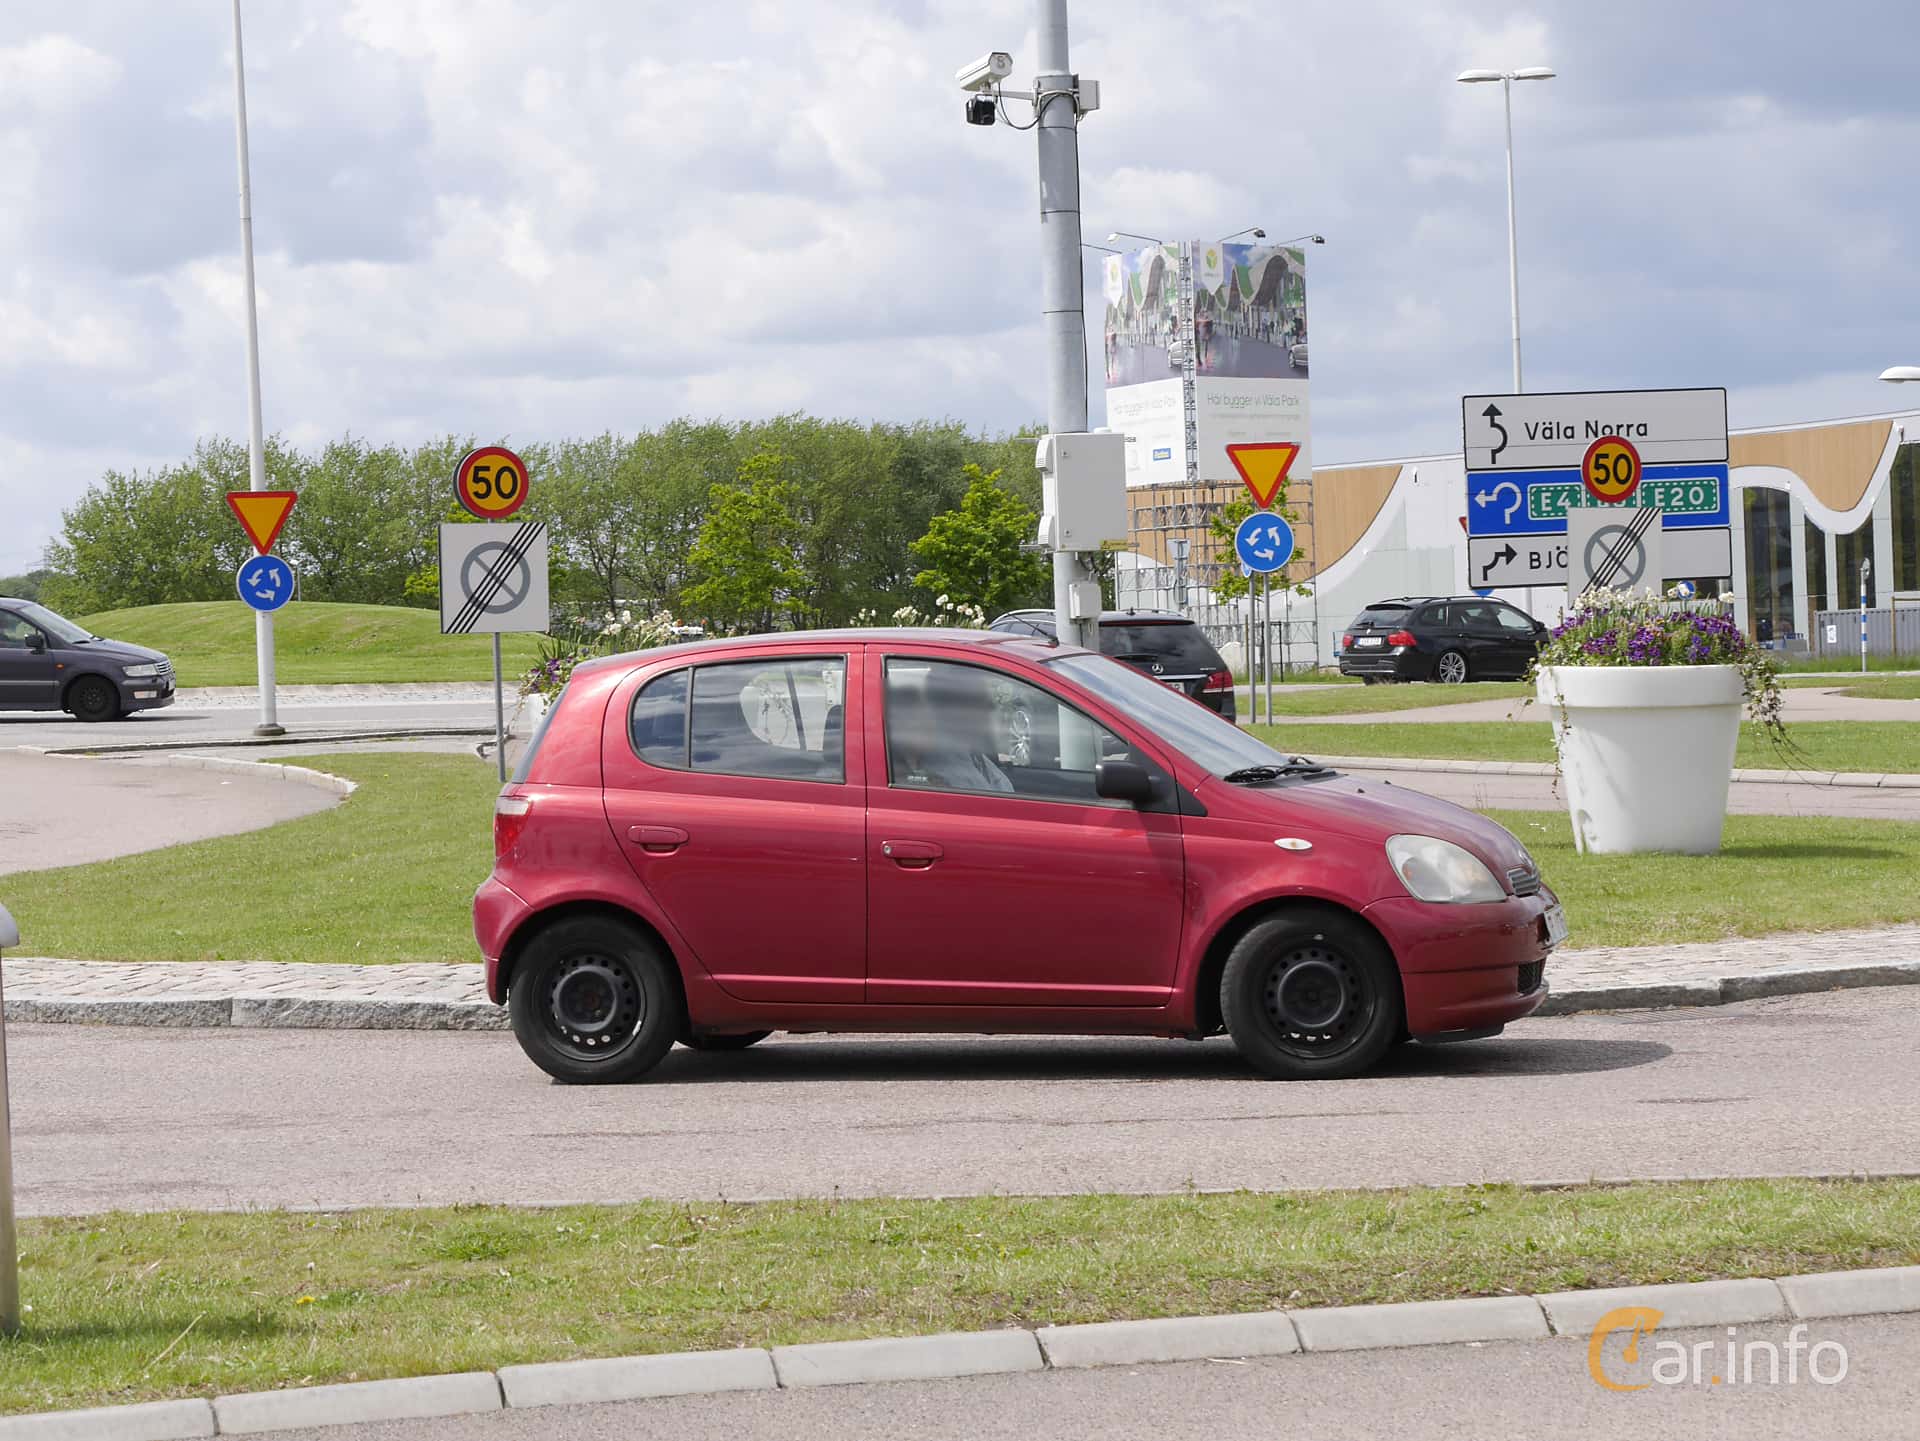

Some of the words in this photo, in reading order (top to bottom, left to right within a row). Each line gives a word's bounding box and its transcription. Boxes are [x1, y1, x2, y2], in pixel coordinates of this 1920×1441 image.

[1524, 421, 1575, 440] Väla
[1585, 420, 1648, 439] Norra
[472, 466, 518, 499] 50
[1593, 453, 1633, 485] 50
[1541, 493, 1571, 511] E4
[1654, 486, 1704, 507] E20
